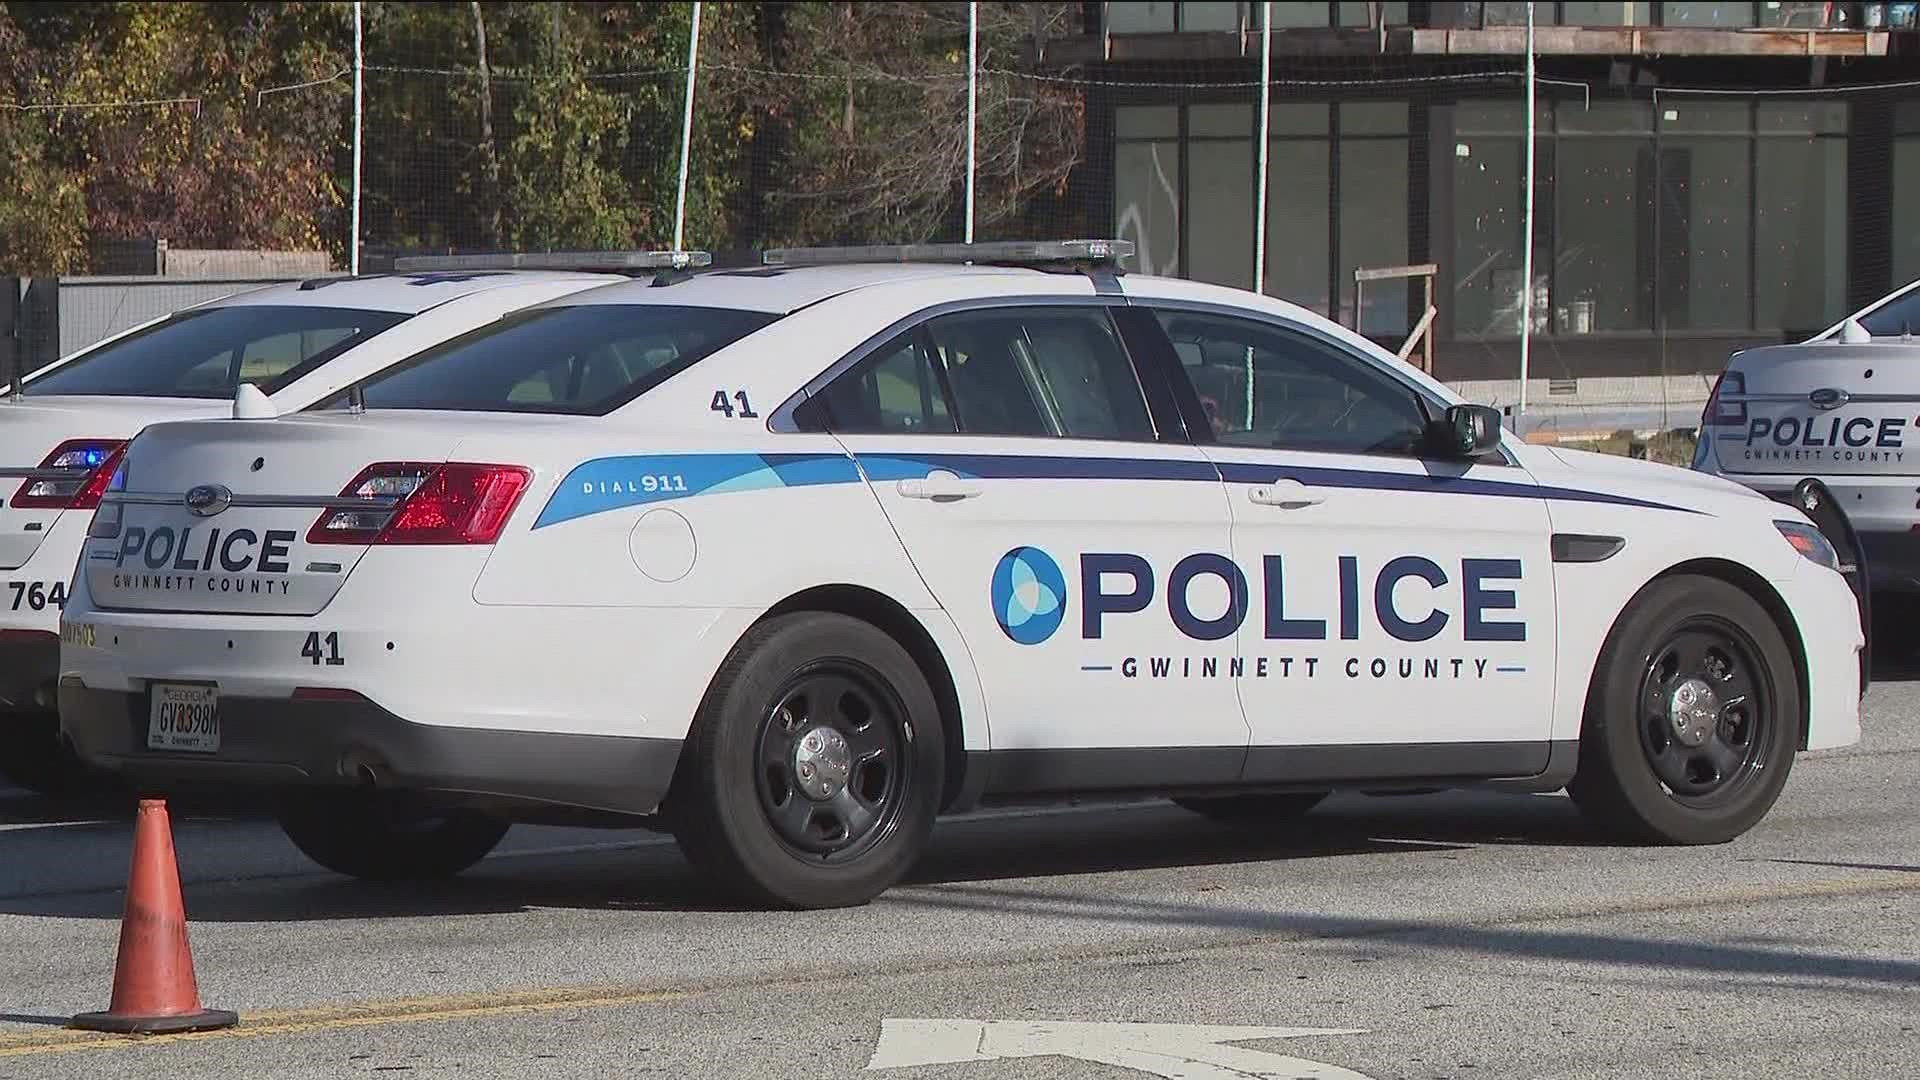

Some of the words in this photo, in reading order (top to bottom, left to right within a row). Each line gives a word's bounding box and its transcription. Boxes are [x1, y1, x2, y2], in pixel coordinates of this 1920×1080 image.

[710, 390, 759, 419] 41
[1745, 416, 1906, 448] POLICE
[1744, 449, 1822, 461] GWINNETT
[1832, 451, 1904, 463] COUNTY
[583, 480, 637, 495] DIAL
[640, 475, 688, 492] 911
[116, 526, 297, 573] POLICE
[9, 581, 66, 611] 764
[113, 575, 195, 590] GWINNETT
[207, 578, 290, 595] COUNTY
[1079, 552, 1526, 642] POLICE
[301, 631, 345, 666] 41
[1121, 657, 1320, 678] GWINNETT
[1345, 657, 1489, 679] COUNTY
